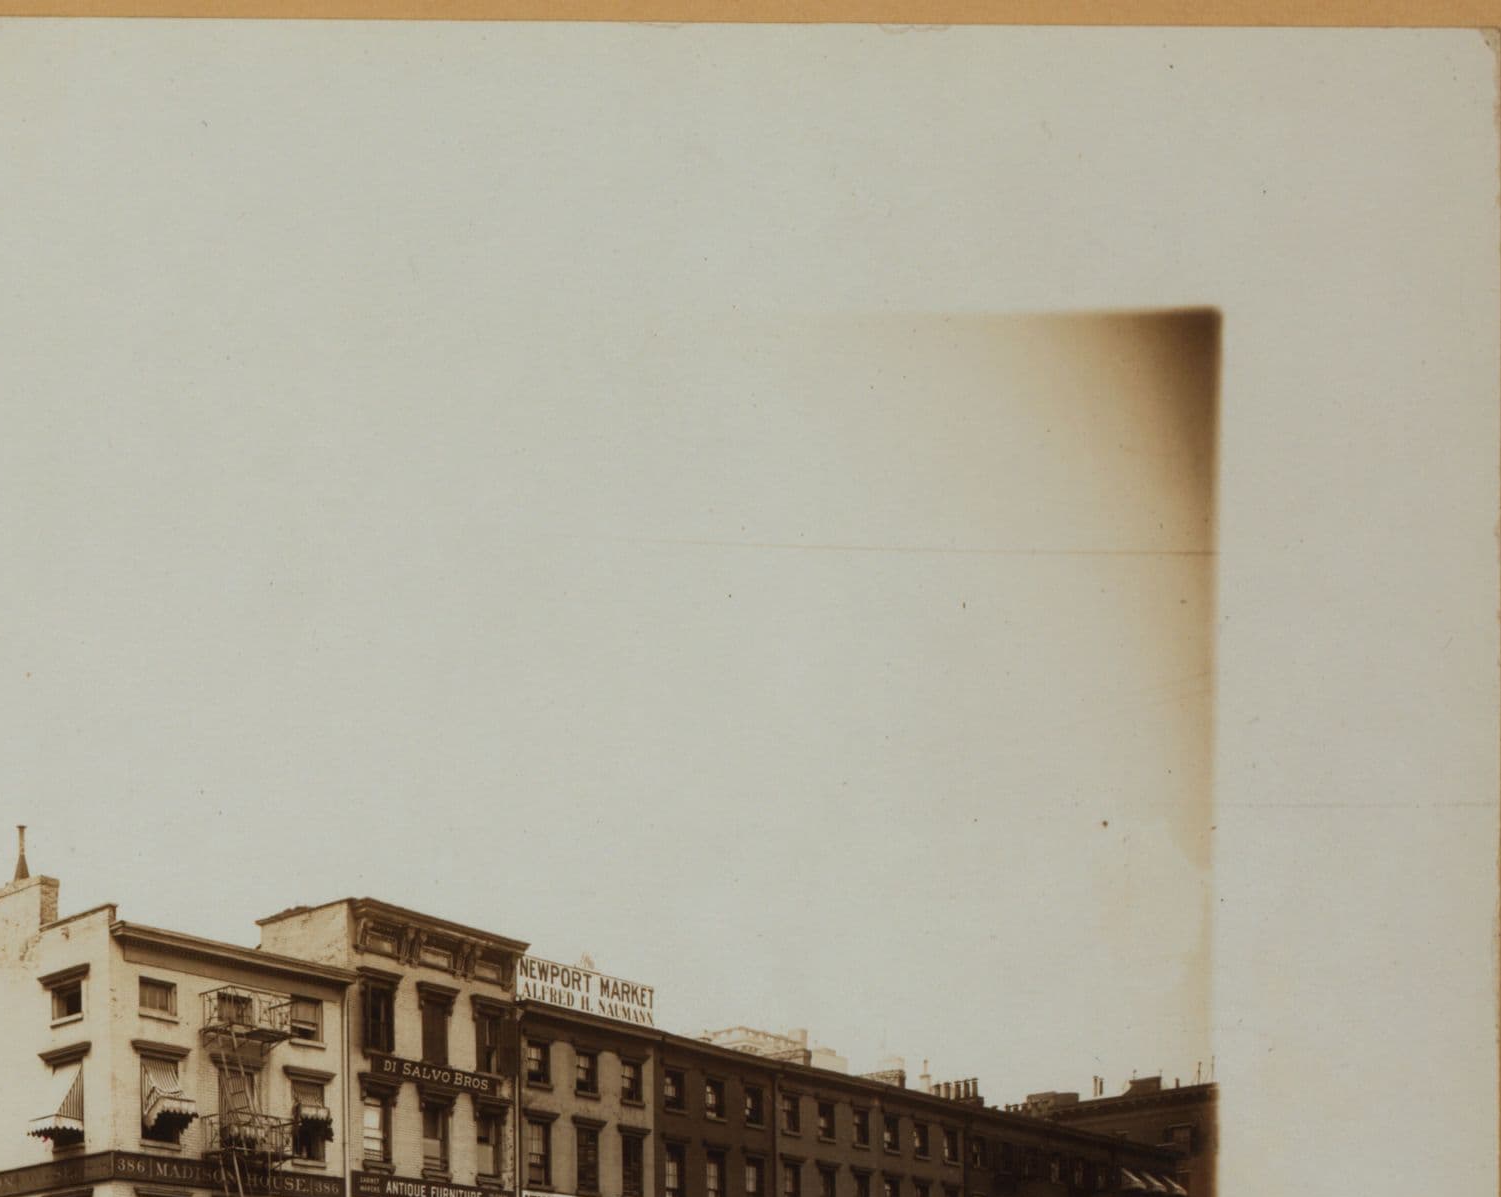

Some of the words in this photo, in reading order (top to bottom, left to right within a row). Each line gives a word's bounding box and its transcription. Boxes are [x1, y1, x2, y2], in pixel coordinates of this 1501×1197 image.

[520, 958, 592, 993] NEWPORT
[600, 977, 655, 1009] MARKET
[523, 981, 574, 1007] ALFRED
[384, 1060, 397, 1073] DI
[403, 1062, 451, 1084] SALVO
[454, 1072, 489, 1091] BROS
[117, 1160, 146, 1173] 386
[156, 1162, 237, 1185] MADISON
[314, 1181, 340, 1194] 386
[386, 1181, 426, 1197] ANTIQUE
